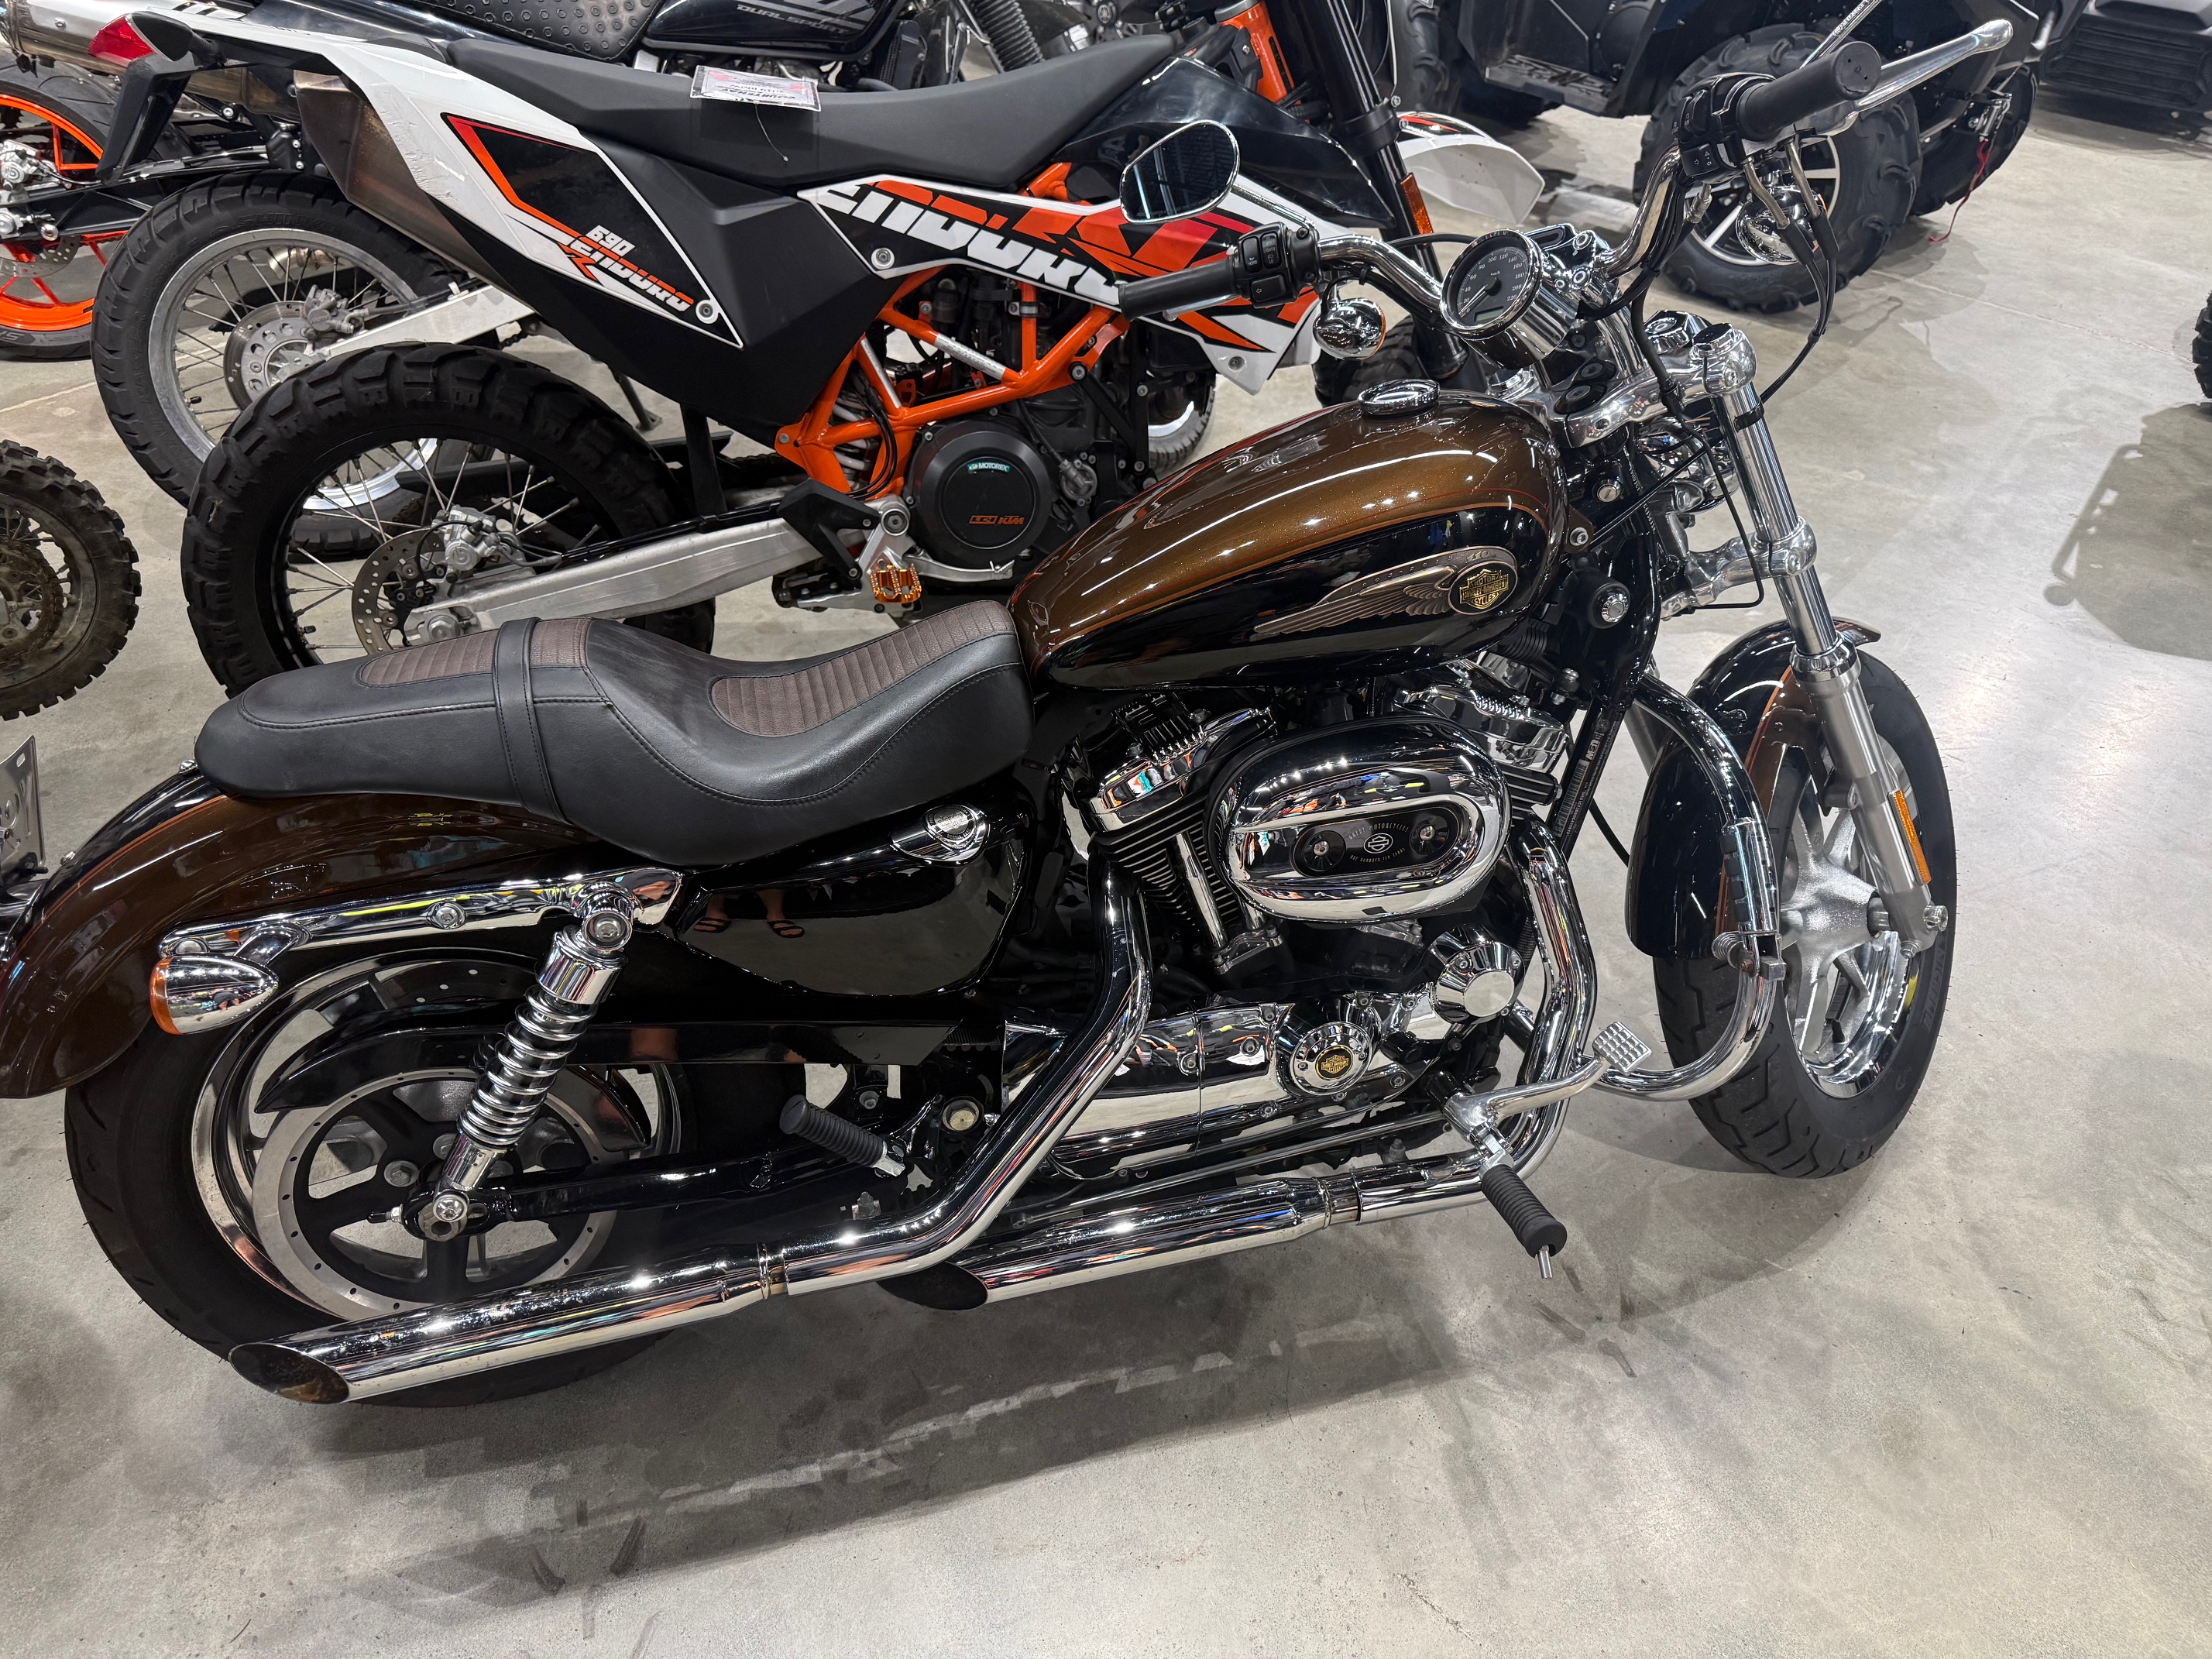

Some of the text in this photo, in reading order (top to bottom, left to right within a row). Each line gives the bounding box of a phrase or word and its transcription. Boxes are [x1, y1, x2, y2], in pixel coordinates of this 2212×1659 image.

[737, 4, 849, 34] DUAL SPORT
[586, 225, 636, 256] 690
[570, 236, 695, 312] ENDURO
[978, 462, 1008, 472] MOTOREX
[998, 516, 1025, 525] KTM
[1474, 592, 1496, 604] CYCLES
